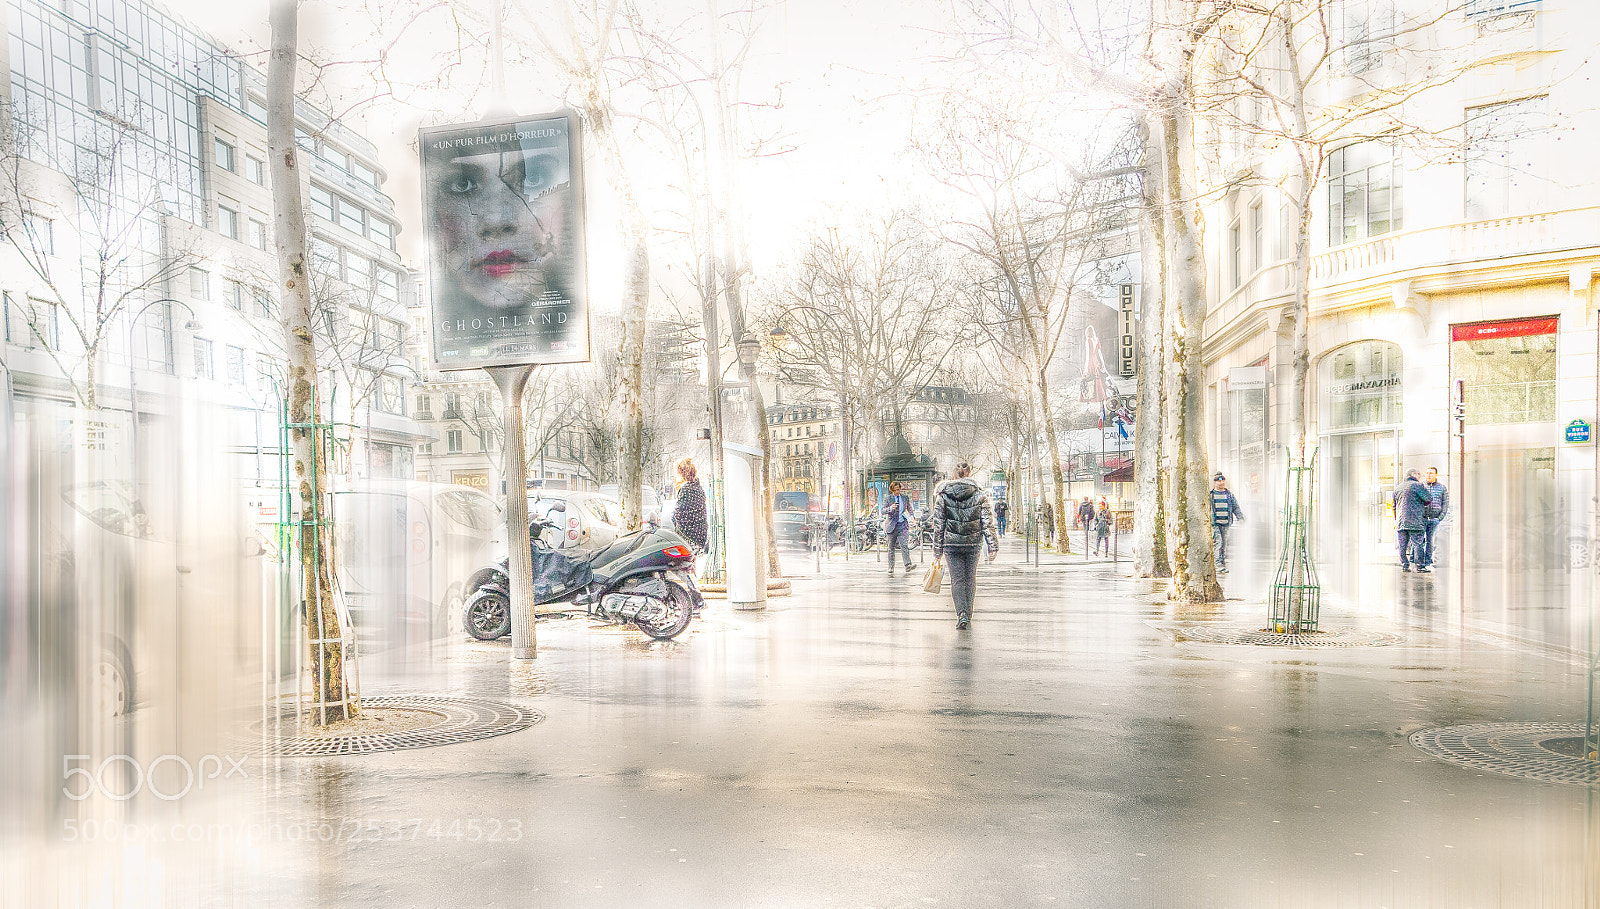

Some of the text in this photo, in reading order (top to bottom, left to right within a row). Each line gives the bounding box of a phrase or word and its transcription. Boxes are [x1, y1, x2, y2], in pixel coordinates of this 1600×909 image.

[455, 137, 474, 147] PUR
[475, 135, 497, 146] FILM
[441, 312, 568, 332] GHOSTLAND
[1121, 284, 1133, 371] OPTIQUE
[455, 477, 488, 486] KENZO
